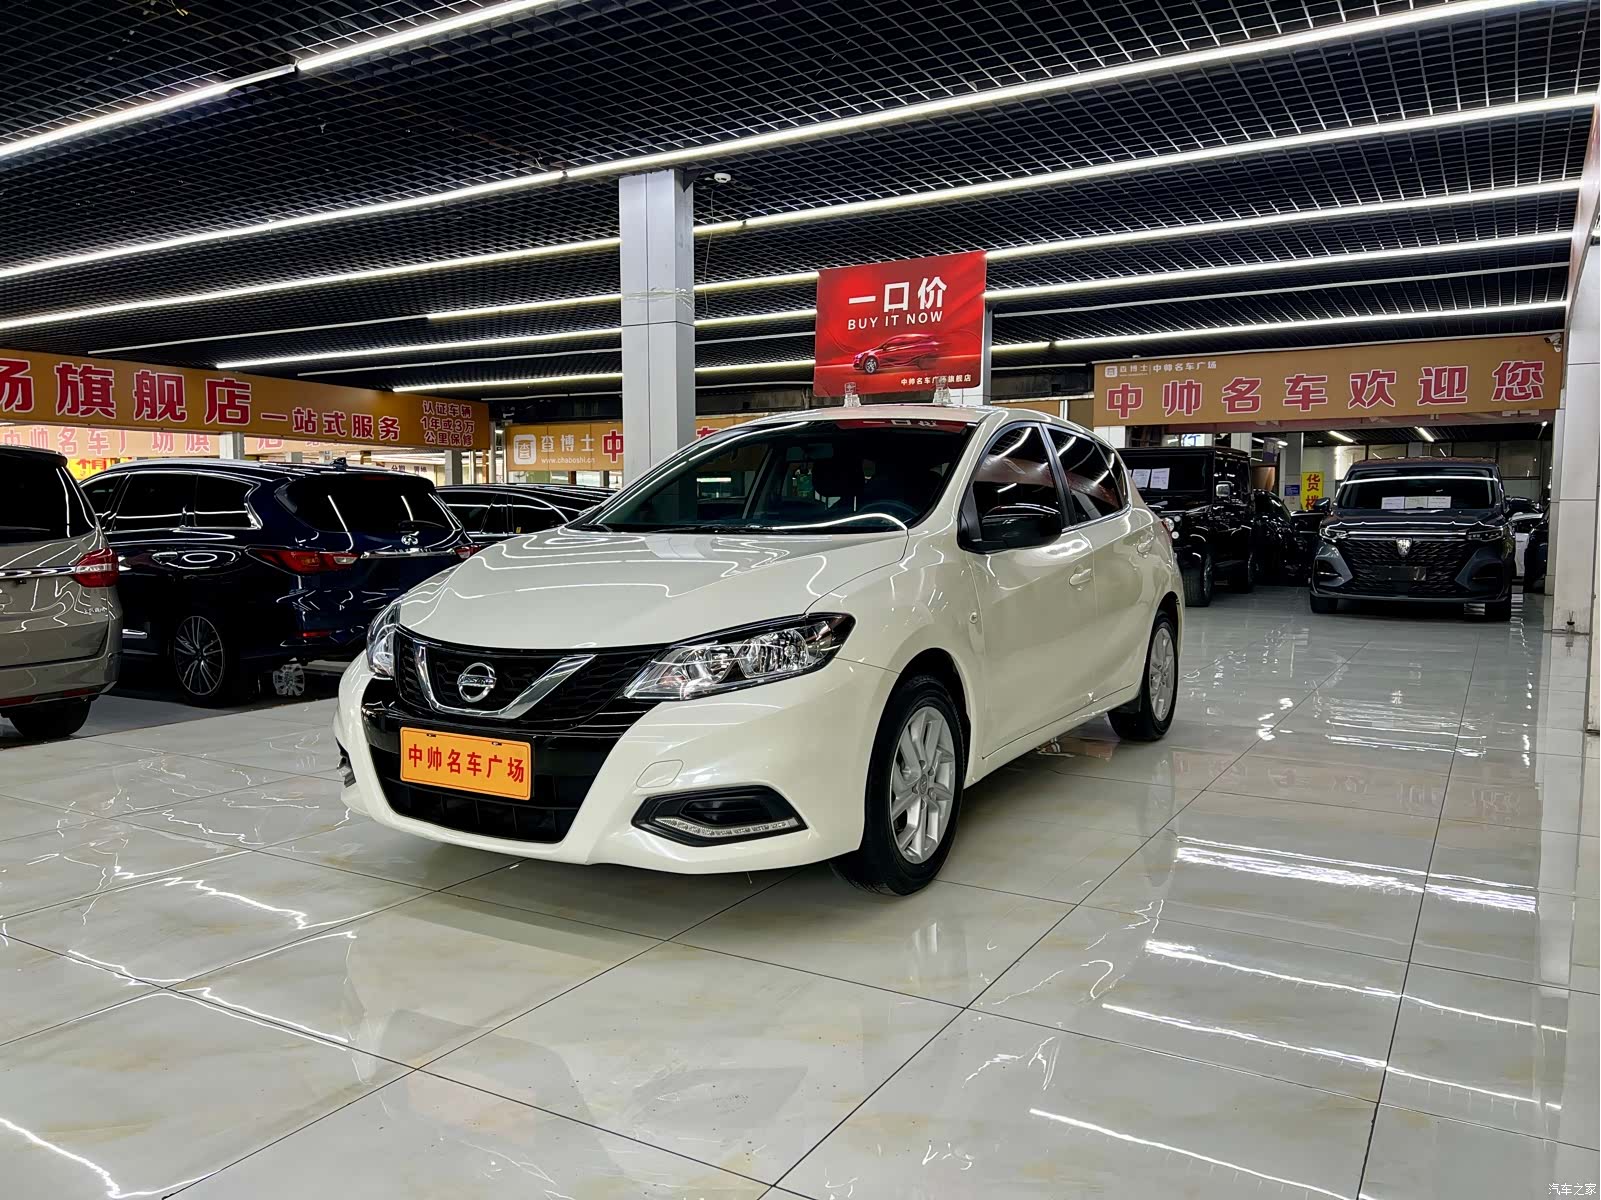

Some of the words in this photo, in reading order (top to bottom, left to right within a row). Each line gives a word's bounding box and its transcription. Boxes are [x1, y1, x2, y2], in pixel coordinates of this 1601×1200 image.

[848, 276, 947, 313] 一口价
[847, 316, 878, 331] BUY
[884, 314, 899, 327] IT
[906, 310, 943, 325] NOW
[1153, 361, 1217, 373] 中帅名车广场
[1106, 359, 1545, 420] 中帅名车欢迎您
[423, 400, 472, 418] 认证车辆
[260, 406, 400, 442] 一站式服务
[420, 416, 475, 433] 1年或3万
[424, 431, 473, 447] 公里保修
[541, 434, 595, 453] 查博士
[541, 456, 596, 464] www.chaboshi.cn
[408, 743, 524, 783] 中帅名车广场
